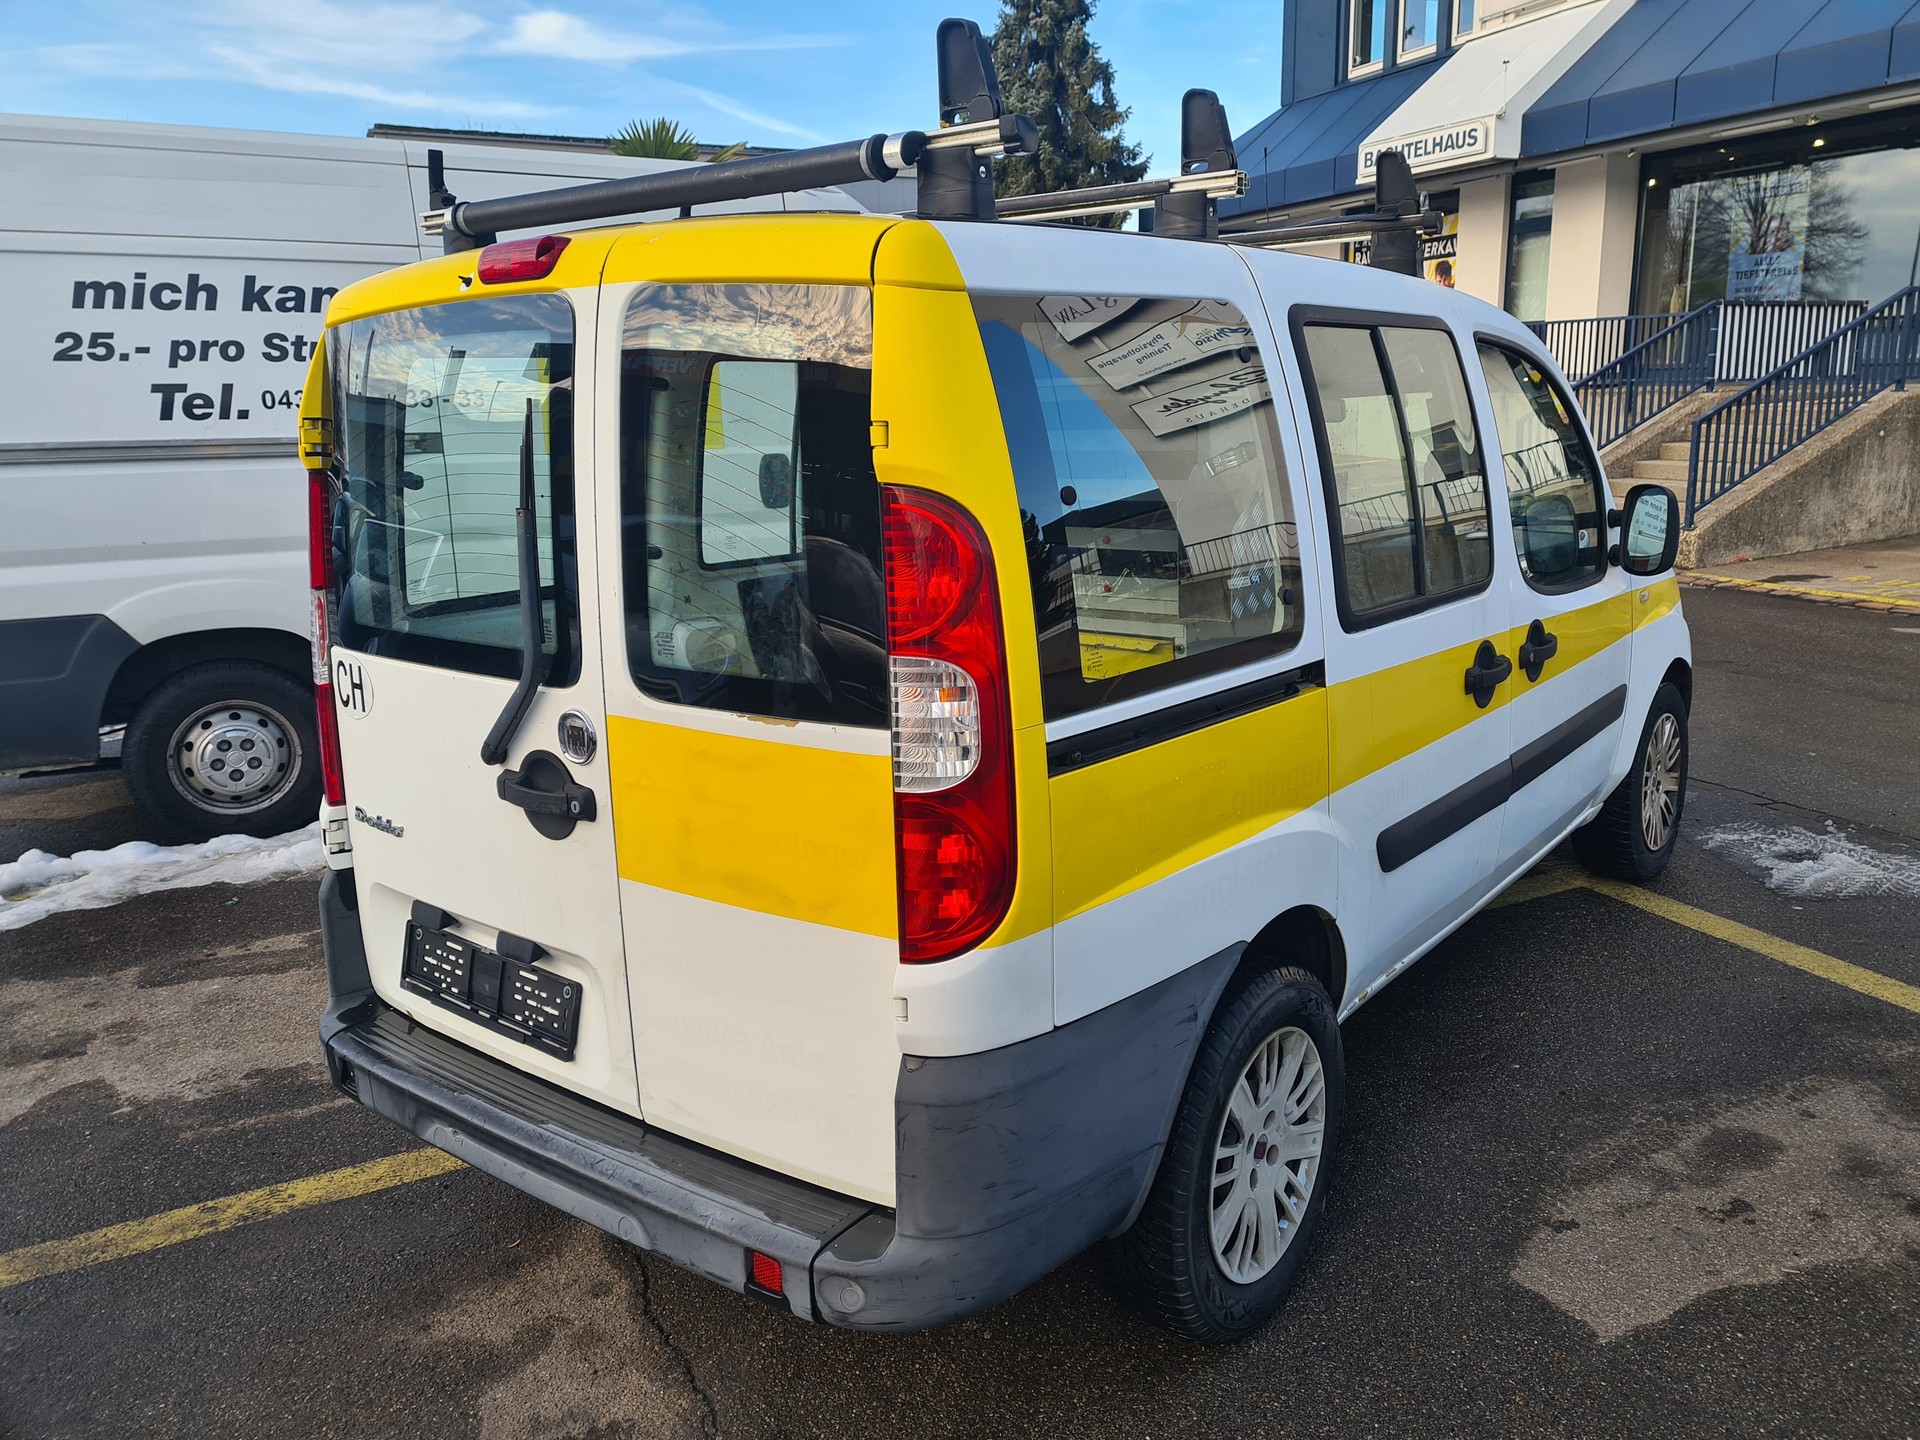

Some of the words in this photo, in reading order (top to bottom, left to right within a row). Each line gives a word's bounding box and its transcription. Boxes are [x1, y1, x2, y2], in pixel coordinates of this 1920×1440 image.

[72, 272, 218, 311] mich
[53, 331, 150, 362] 25.-
[168, 338, 245, 368] pro
[150, 383, 250, 421] Tel.
[336, 659, 366, 714] CH
